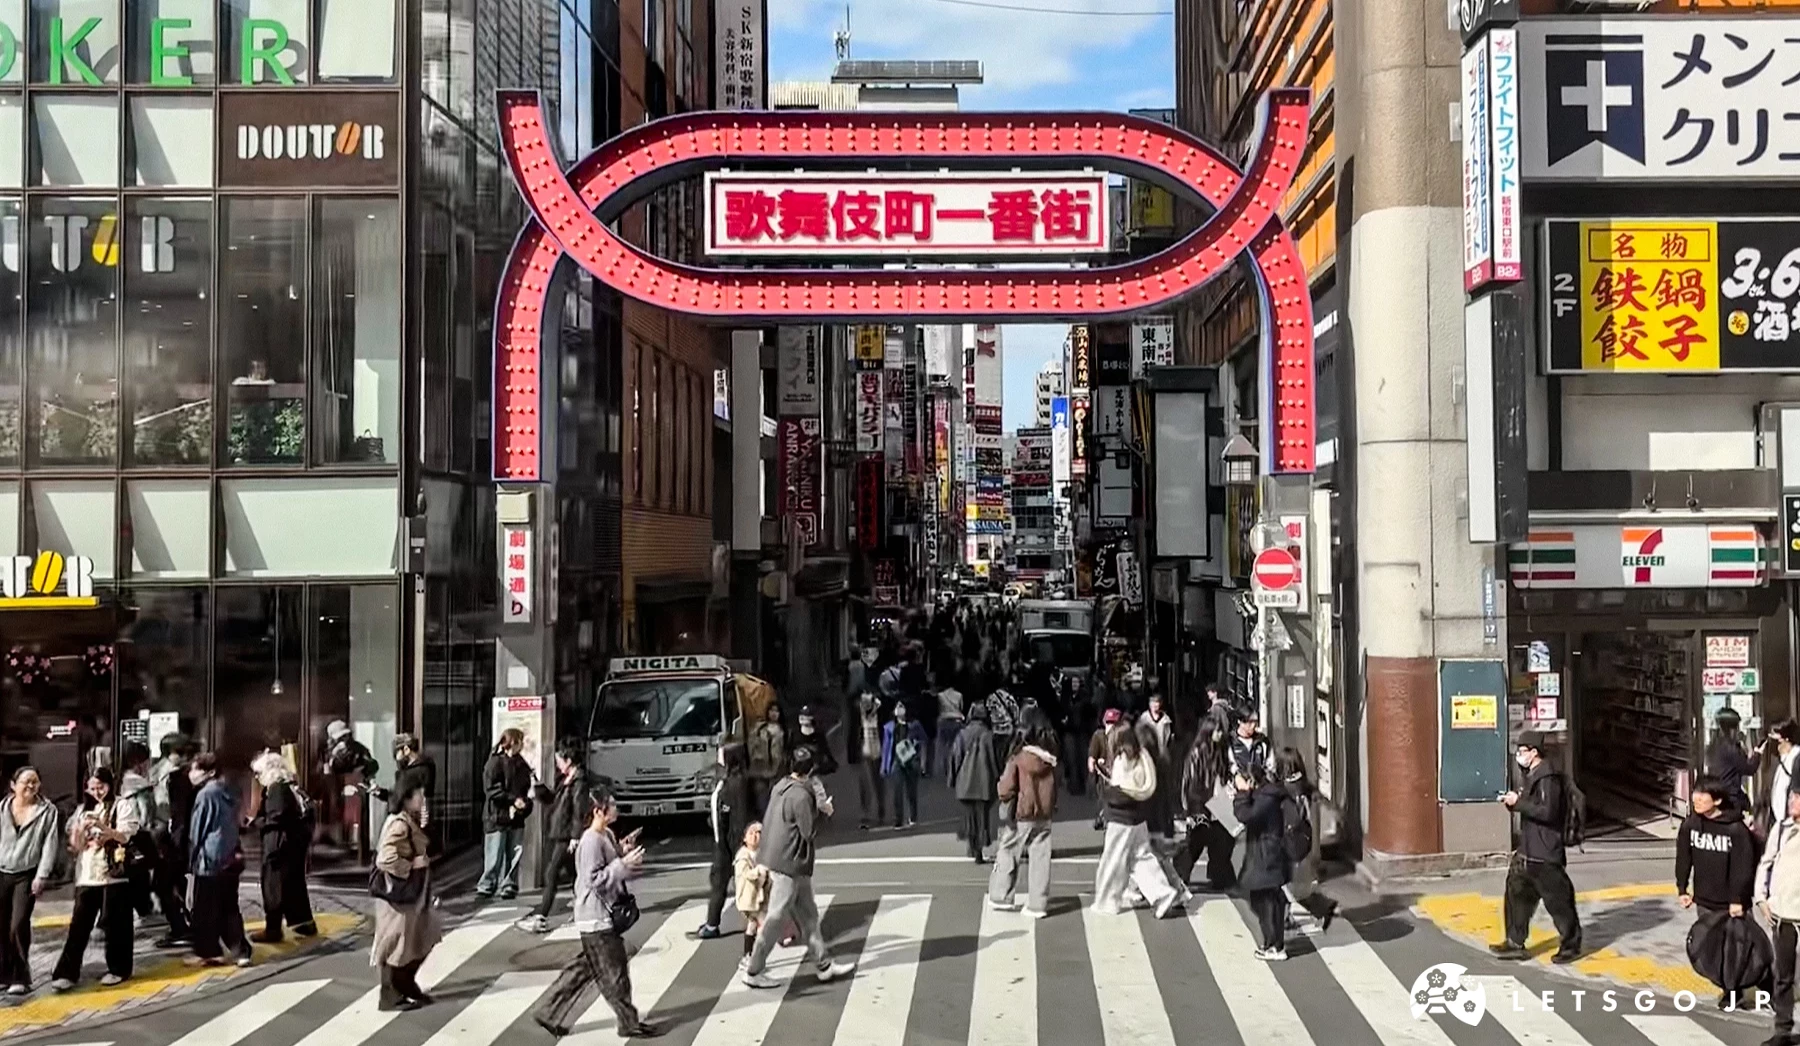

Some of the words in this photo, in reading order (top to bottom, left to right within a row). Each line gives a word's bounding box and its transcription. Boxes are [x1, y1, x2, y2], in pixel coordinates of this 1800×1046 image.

[0, 18, 297, 86] KER
[237, 120, 385, 160] DOUTOR
[1494, 56, 1515, 192] ファイトフィット
[725, 189, 1092, 242] 歌舞伎町一番街
[1501, 195, 1513, 258] 新宿東口駅前
[1612, 232, 1688, 260] 名物
[1589, 267, 1707, 313] 鉄鍋
[1591, 314, 1708, 363] 餃子
[1731, 315, 1745, 333] 365
[1753, 300, 1800, 341] 酒
[508, 530, 527, 617] 劇場通り
[1485, 625, 1495, 633] 17
[1709, 638, 1747, 647] ATM
[623, 657, 700, 669] NIGITA
[1703, 672, 1735, 687] たばこ
[1741, 672, 1756, 687] 酒
